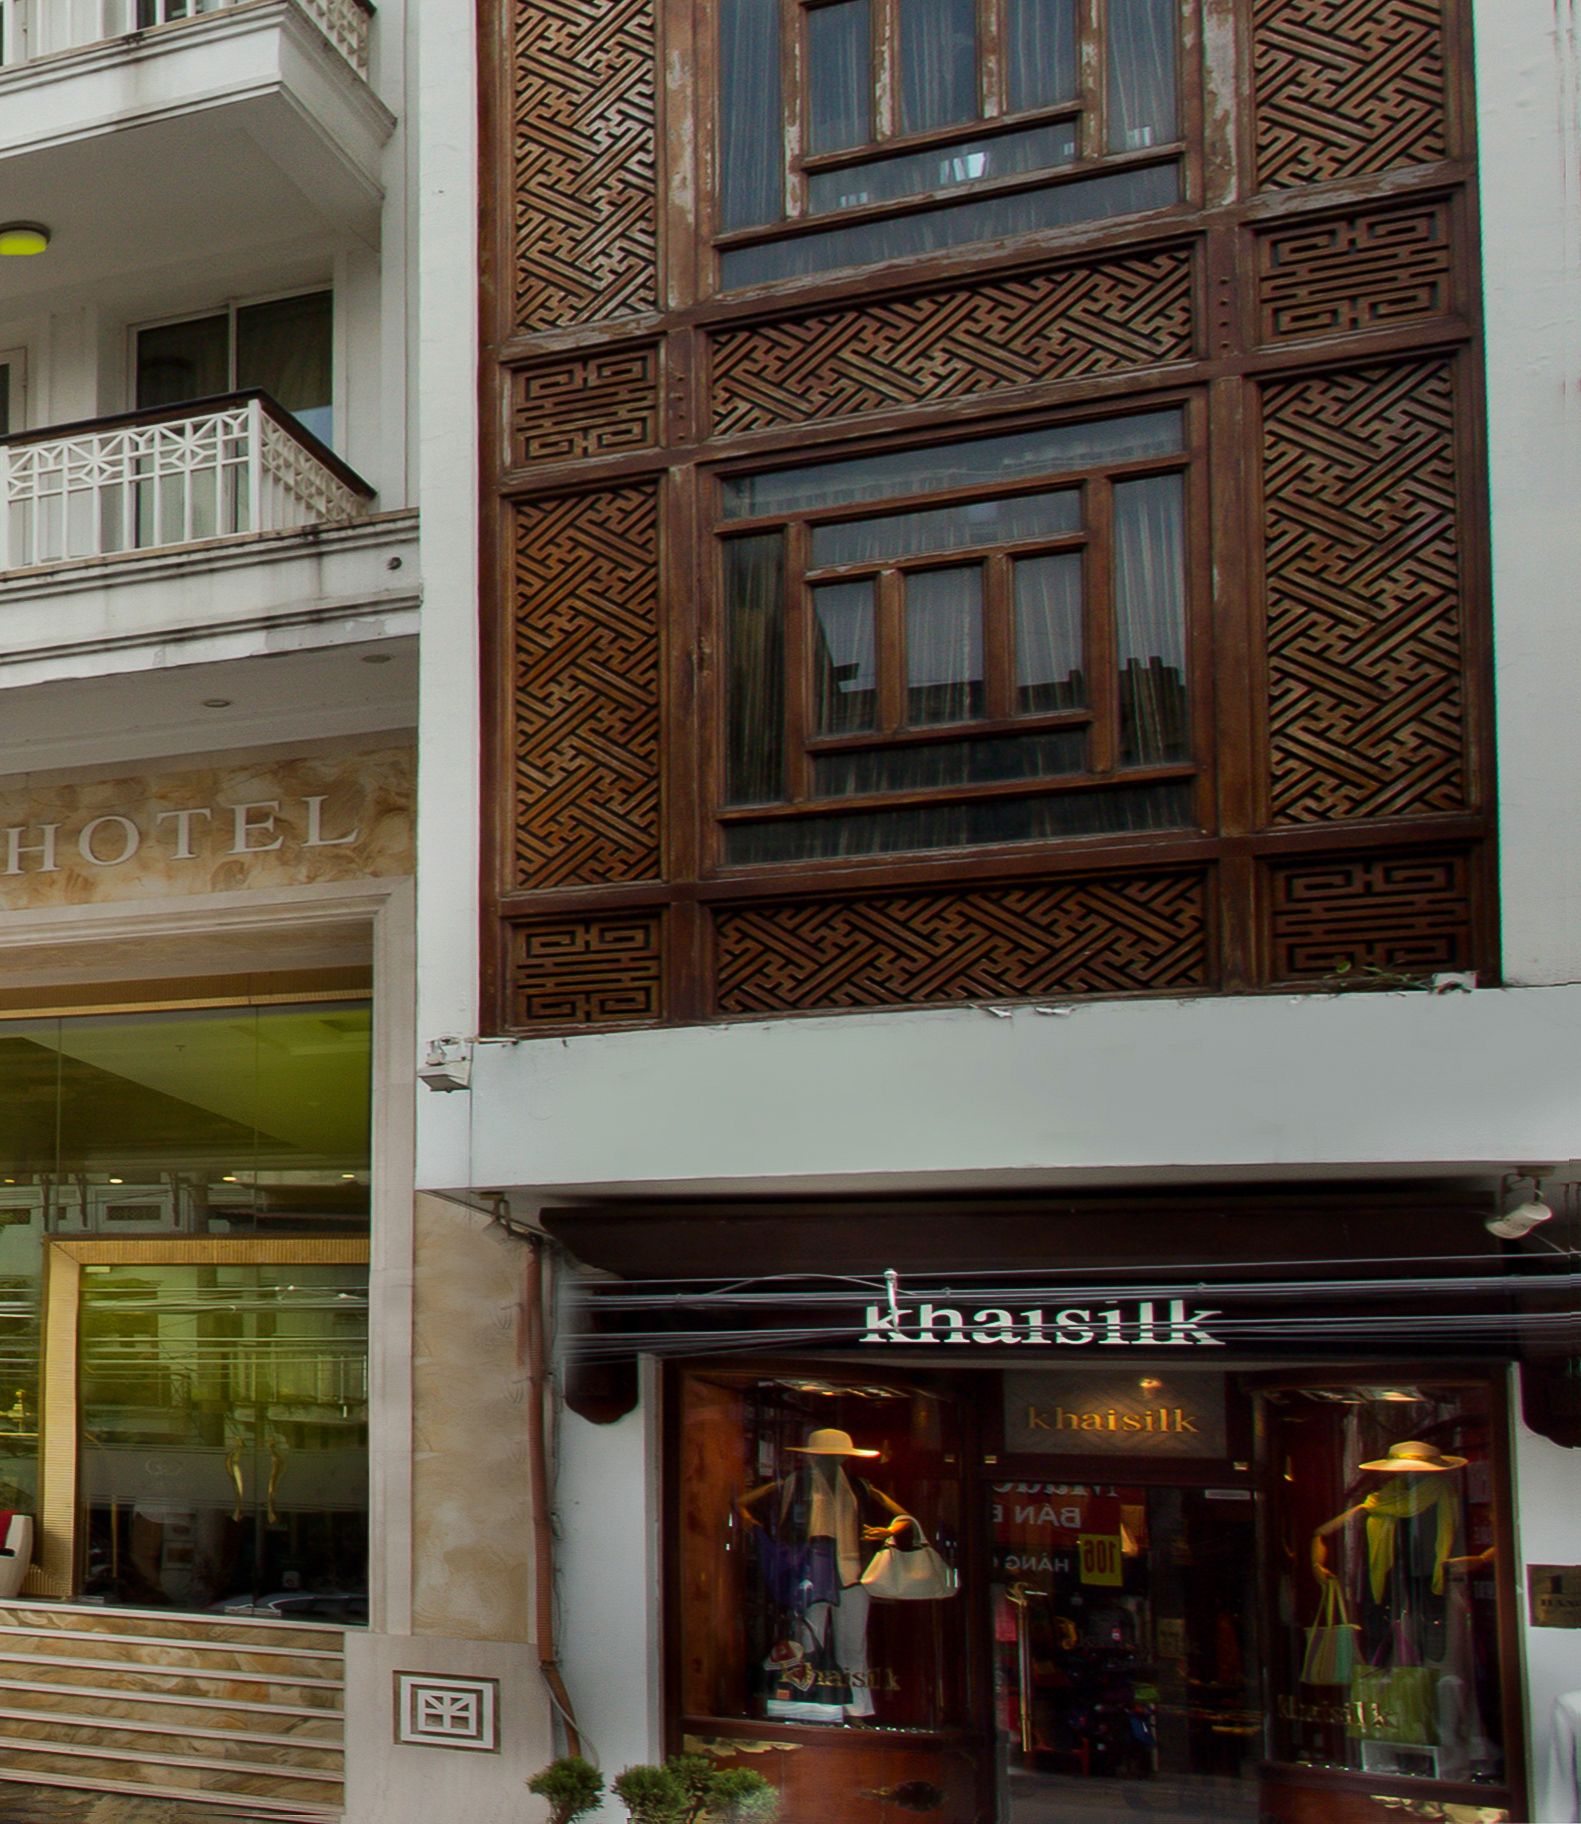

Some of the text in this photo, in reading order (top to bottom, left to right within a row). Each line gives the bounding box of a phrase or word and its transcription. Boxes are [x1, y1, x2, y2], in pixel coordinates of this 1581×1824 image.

[5, 794, 360, 876] HOTEL
[859, 1299, 1227, 1345] khaisilk
[1027, 1406, 1200, 1435] khaisilk
